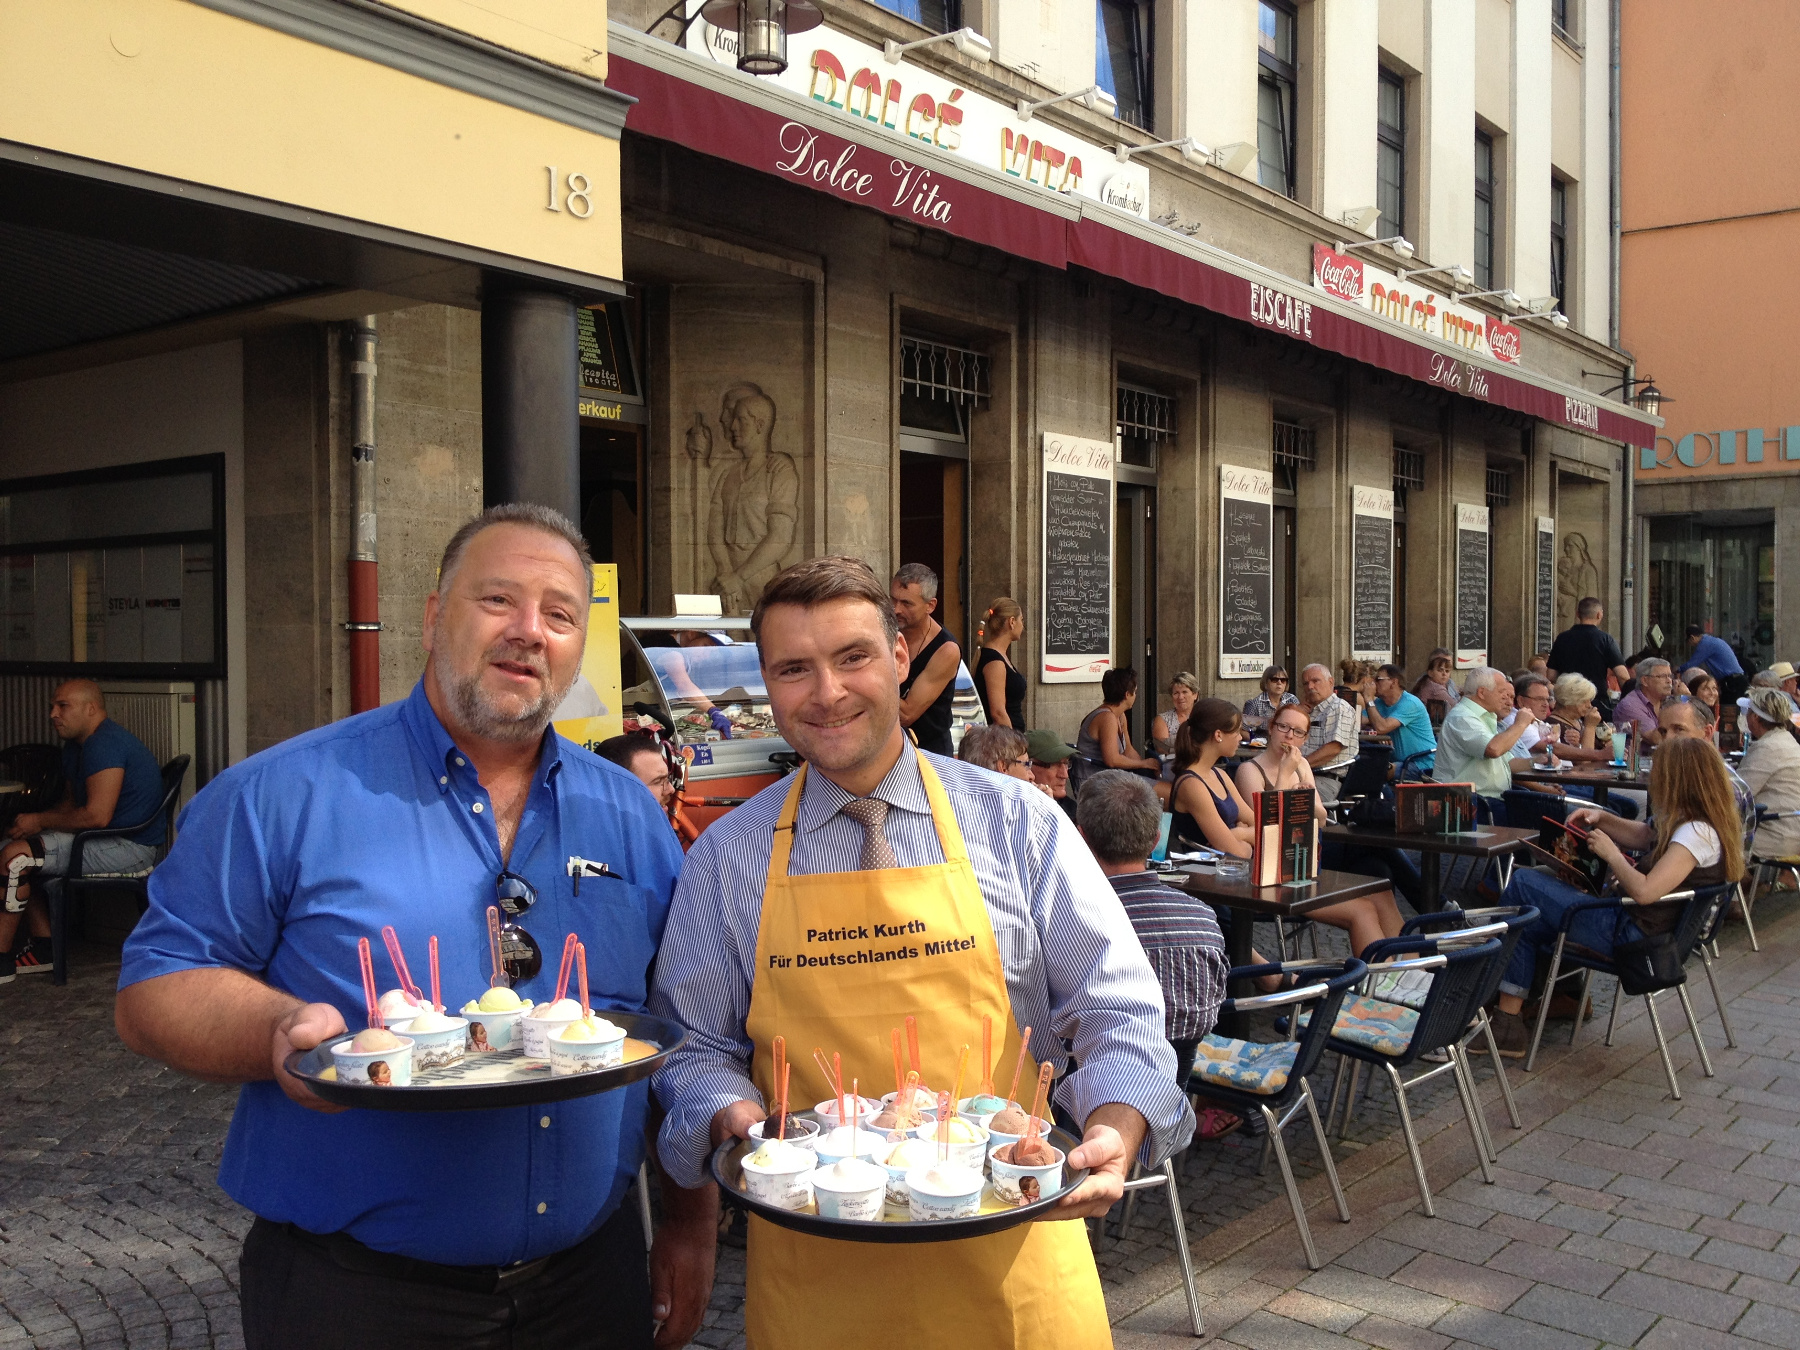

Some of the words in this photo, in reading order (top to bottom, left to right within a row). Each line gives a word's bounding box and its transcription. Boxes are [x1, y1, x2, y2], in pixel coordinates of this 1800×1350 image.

[776, 122, 873, 196] Dolce
[890, 159, 952, 224] Vita
[1001, 127, 1082, 192] VITA
[545, 165, 594, 219] 18
[1107, 188, 1142, 213] Krombacher
[1321, 257, 1361, 297] Coca-Cola
[1251, 282, 1313, 338] EISCAFE
[1443, 311, 1482, 350] VITA
[1429, 353, 1462, 389] Dolce
[1466, 364, 1489, 397] Vita
[1048, 441, 1083, 466] Dolce
[1086, 446, 1111, 470] Vita
[1225, 471, 1250, 492] Dolce
[1253, 475, 1271, 495] Vita
[807, 925, 869, 943] Patrick
[874, 919, 926, 938] Kurth
[769, 955, 792, 969] Für
[796, 946, 918, 968] Deutschlands
[925, 935, 976, 957] Mitte!
